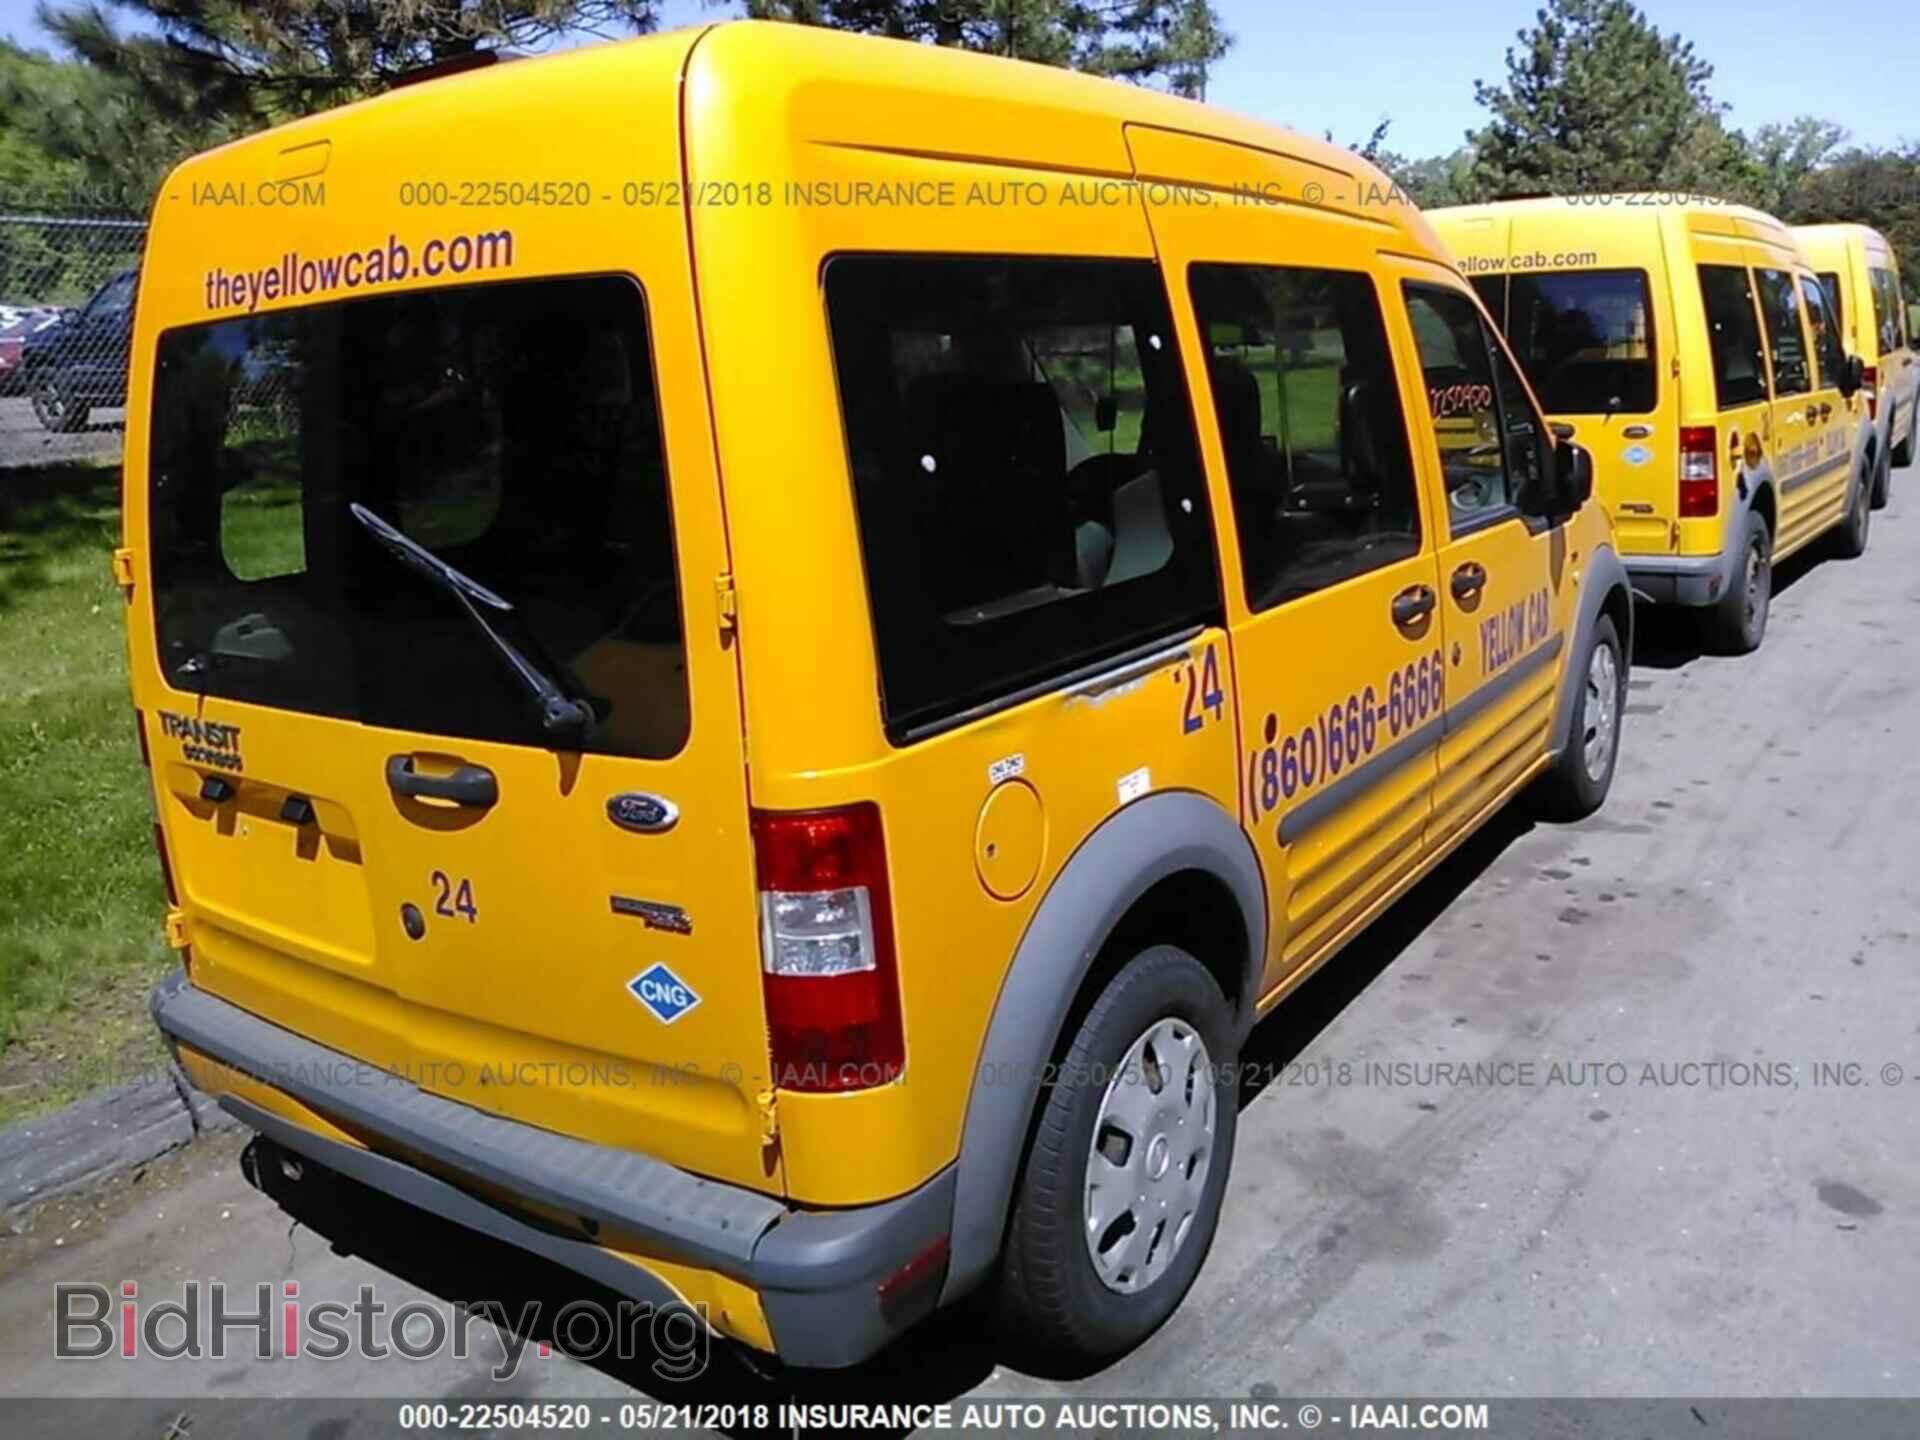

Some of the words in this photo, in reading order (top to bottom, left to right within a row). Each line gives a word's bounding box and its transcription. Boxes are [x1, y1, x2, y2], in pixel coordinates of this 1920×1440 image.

[205, 229, 514, 312] theyellowcab.com
[1480, 599, 1525, 676] YELLOW
[1529, 587, 1549, 645] CAB
[1173, 642, 1224, 735] 24
[156, 709, 241, 752] TRANSIT
[1250, 649, 1443, 825] (860)666-6666
[431, 869, 477, 923] 24
[640, 979, 688, 1008] CNG
